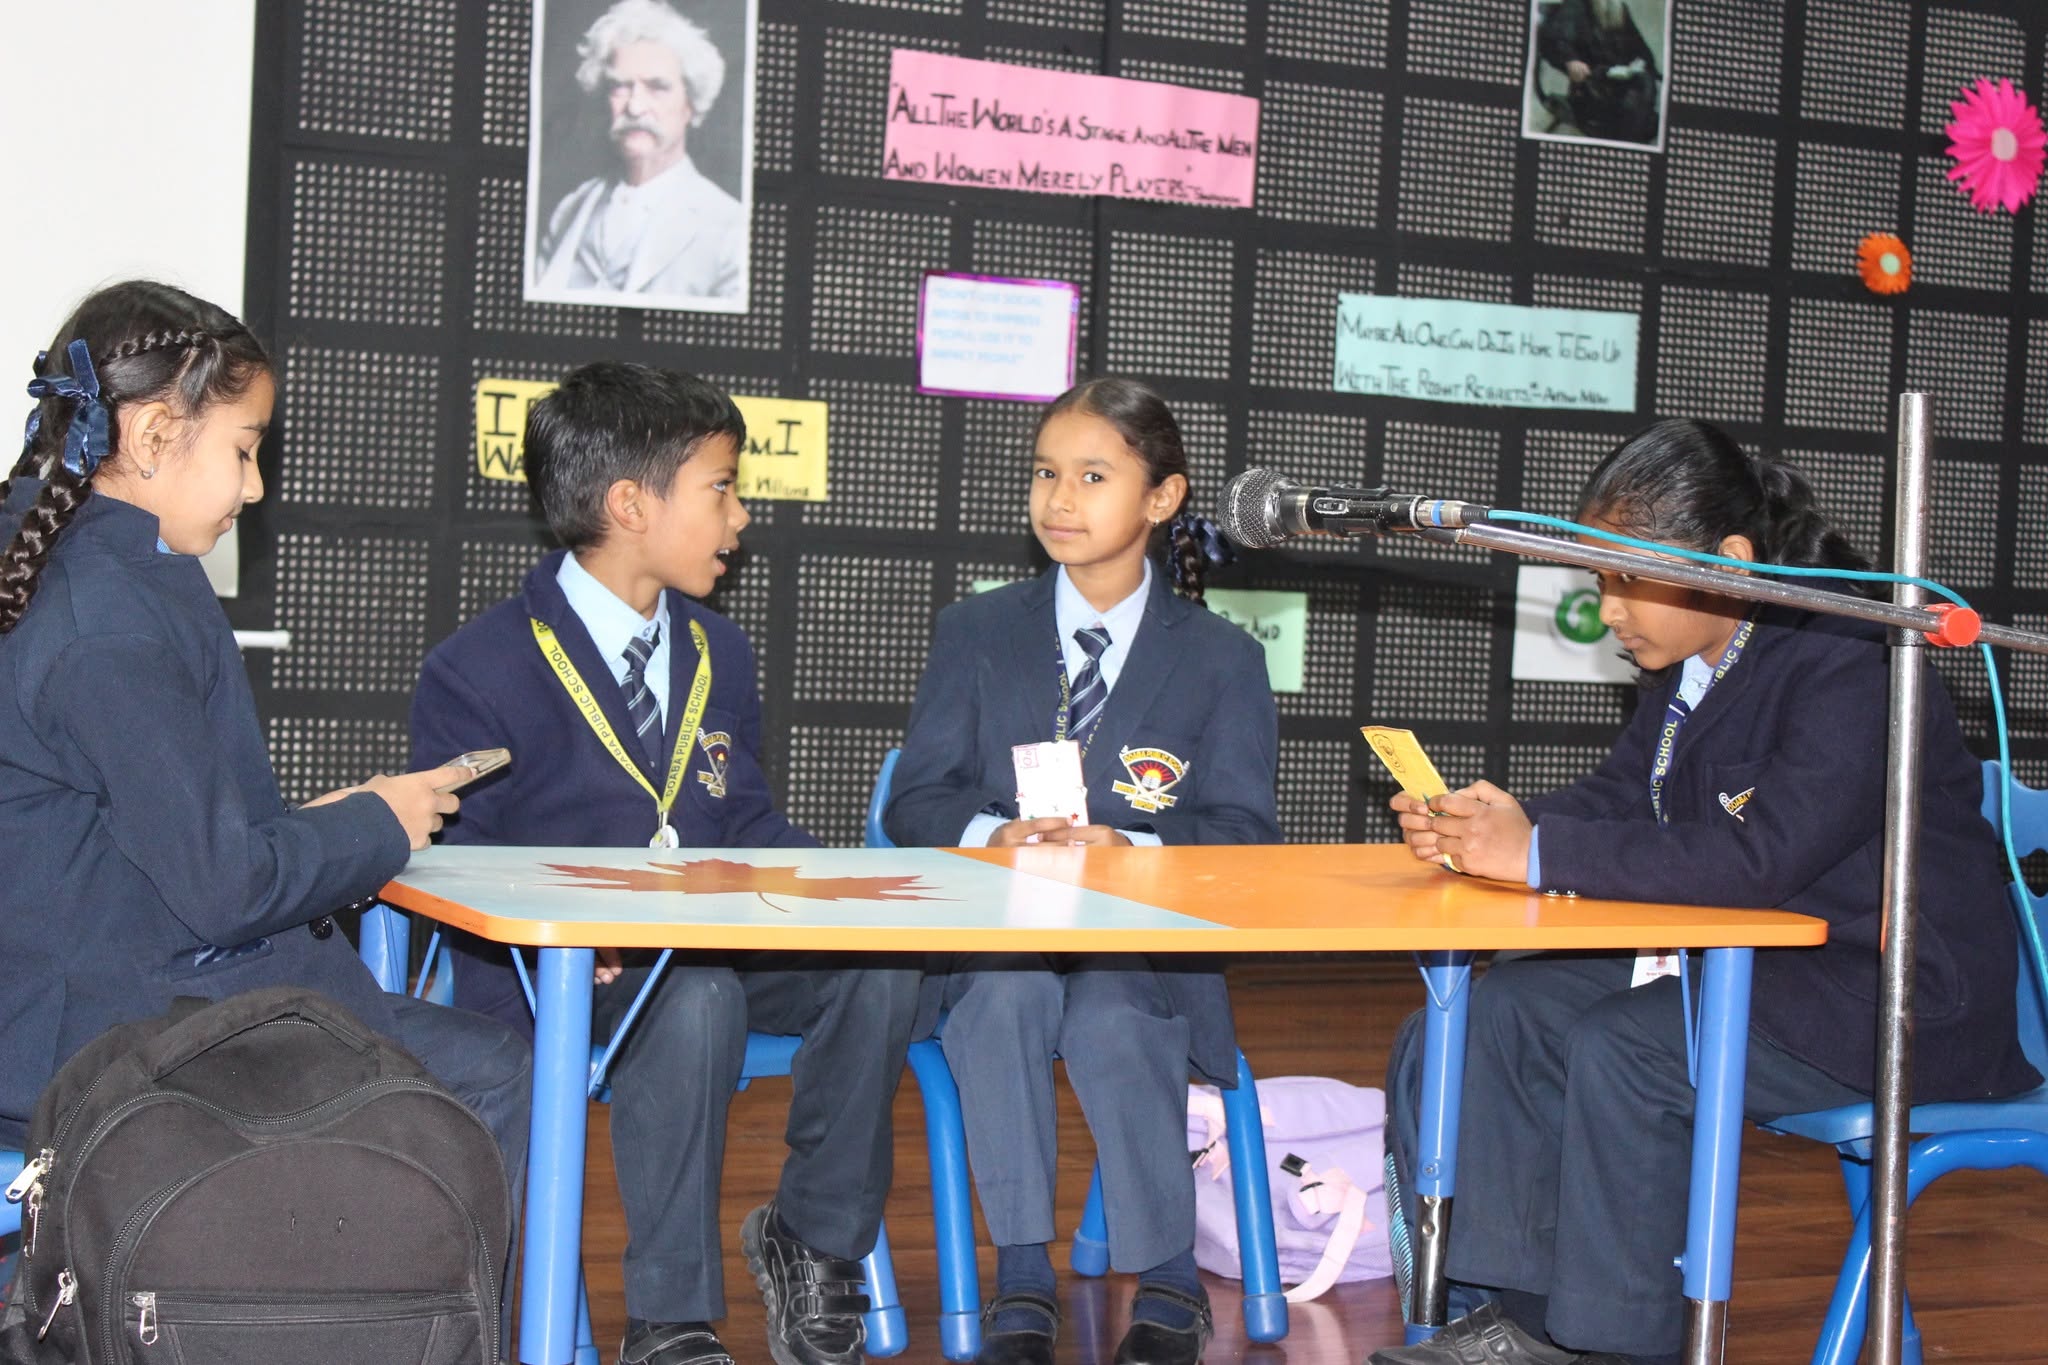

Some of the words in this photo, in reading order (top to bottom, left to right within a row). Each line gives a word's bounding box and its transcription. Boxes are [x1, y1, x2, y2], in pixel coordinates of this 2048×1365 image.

[1057, 114, 1073, 138] A
[884, 147, 927, 179] AND
[935, 151, 1012, 184] WOMEN
[1016, 161, 1103, 190] MERELY
[1602, 338, 1622, 363] UP
[1379, 364, 1410, 394] THE
[482, 391, 517, 437] I
[775, 419, 802, 456] I
[549, 645, 583, 693] SCHOOL
[579, 695, 611, 738] PUBLIC
[666, 756, 685, 797] DOABA
[676, 718, 696, 756] PUBLIC
[688, 674, 709, 714] SCHOOL
[609, 739, 640, 778] DOABA
[1654, 720, 1678, 776] SCHOOL
